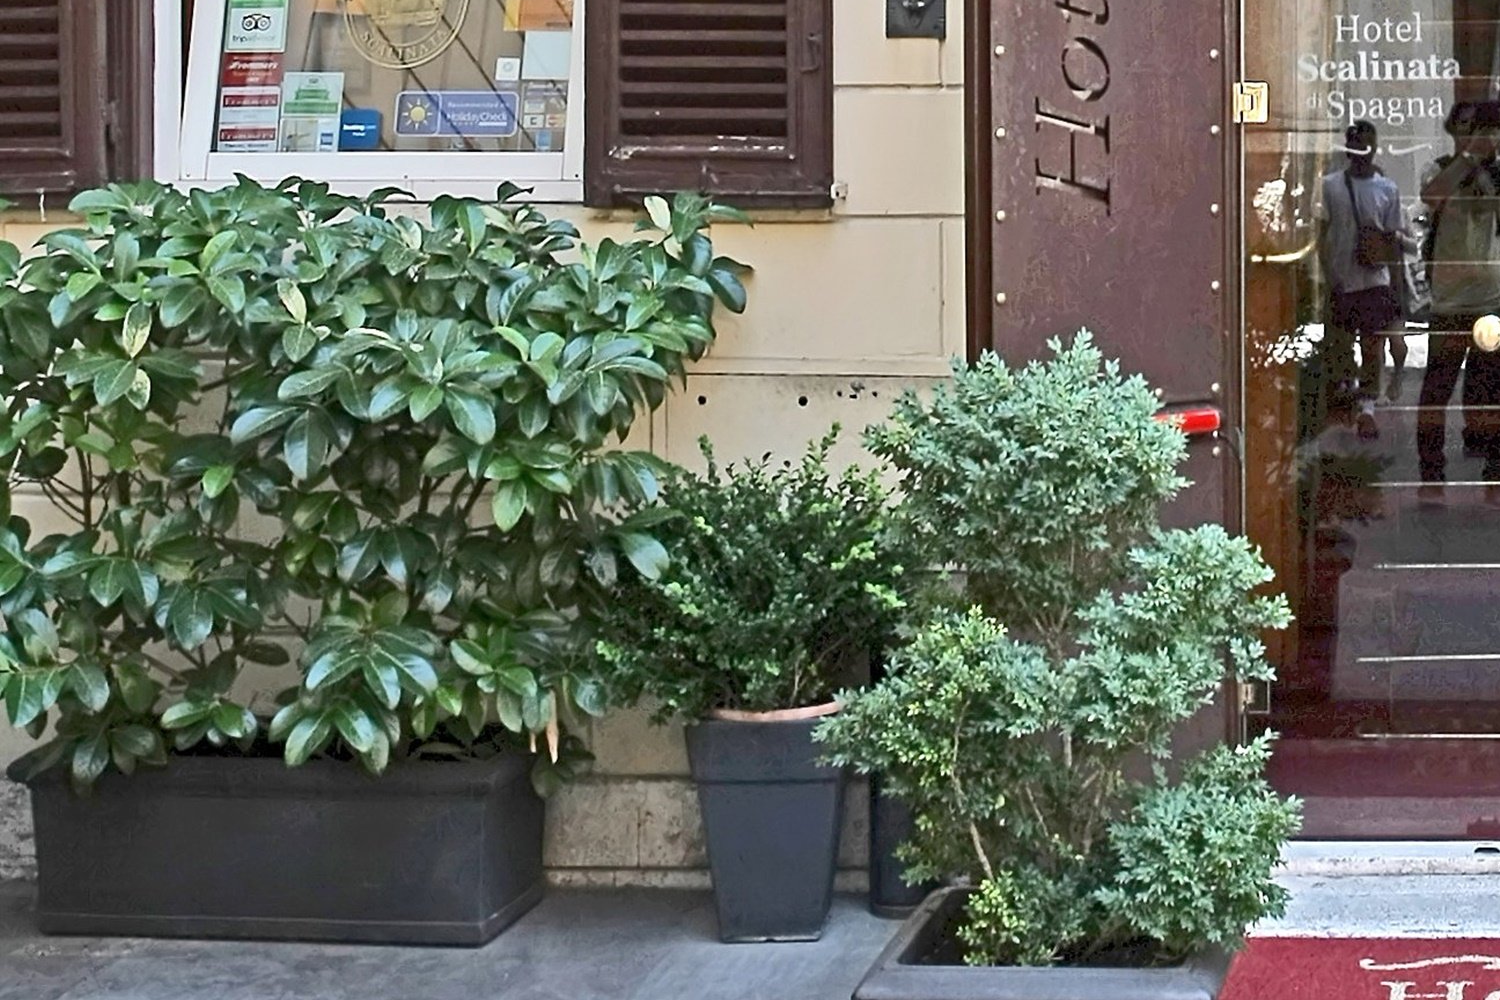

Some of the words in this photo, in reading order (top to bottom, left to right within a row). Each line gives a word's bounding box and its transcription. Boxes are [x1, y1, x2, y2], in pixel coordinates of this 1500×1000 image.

[1335, 12, 1422, 43] Hotel
[1297, 50, 1463, 82] Scalinata
[1306, 92, 1322, 109] di
[1326, 90, 1444, 127] Spagna
